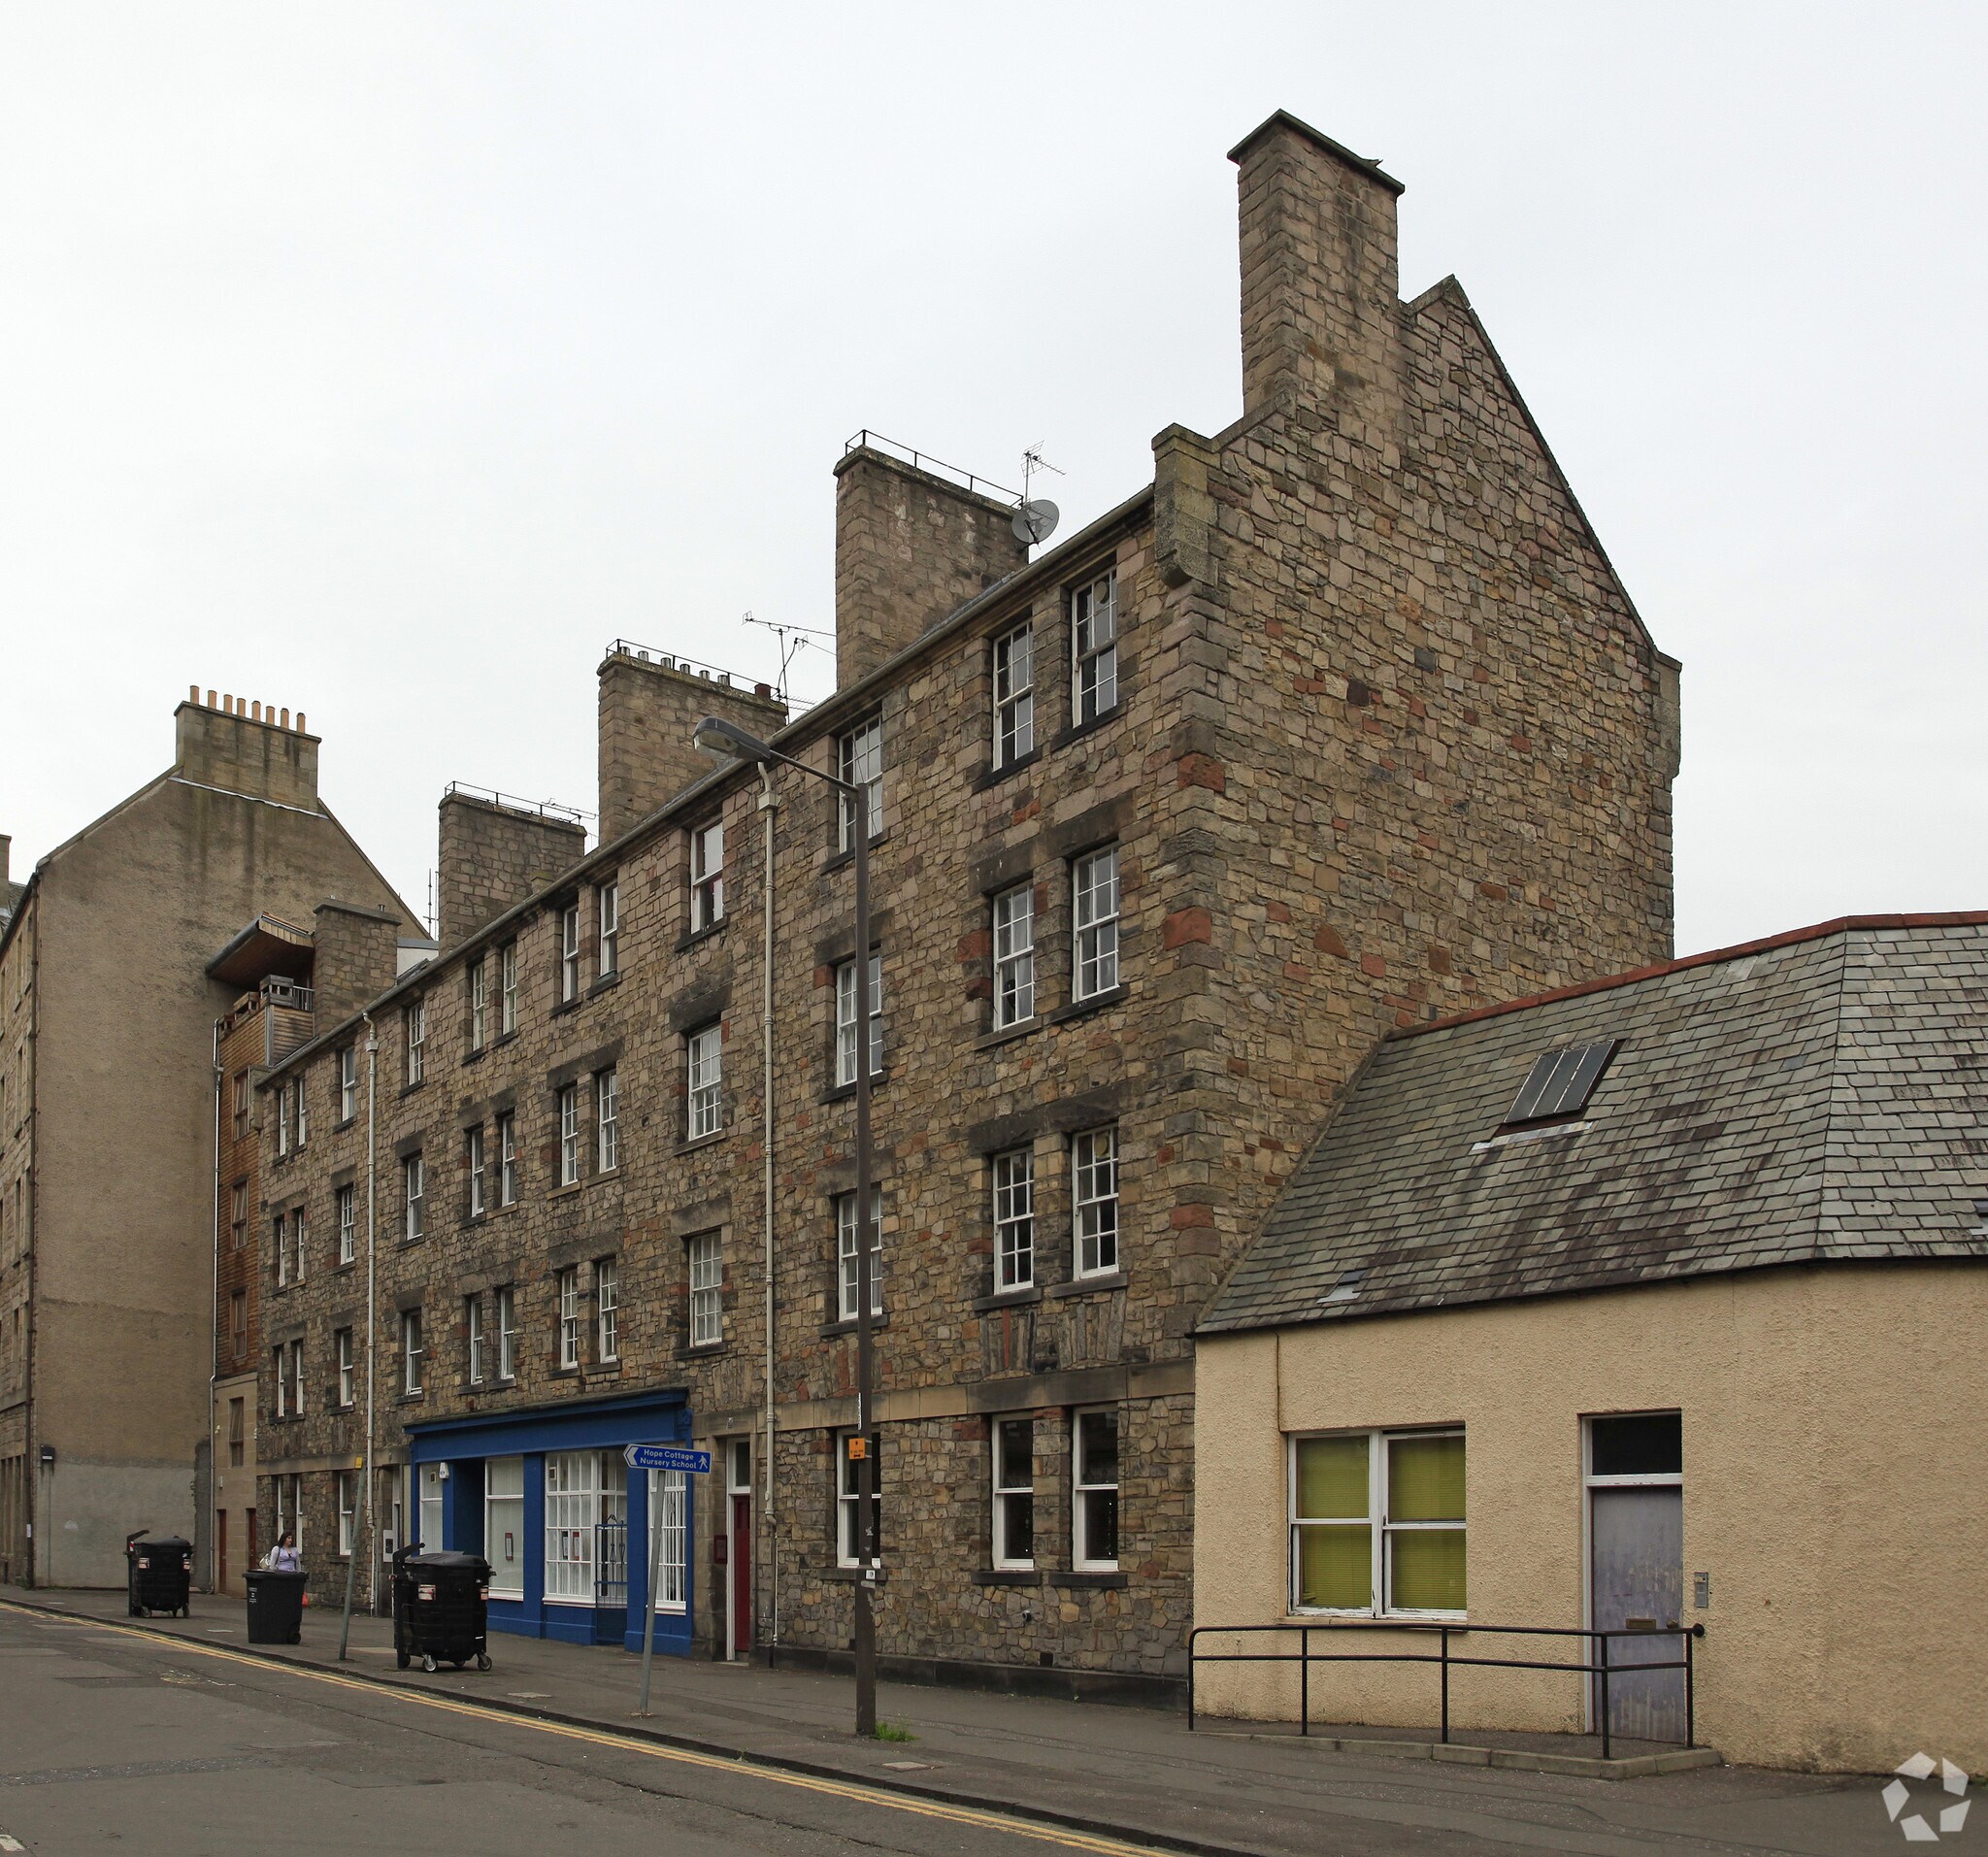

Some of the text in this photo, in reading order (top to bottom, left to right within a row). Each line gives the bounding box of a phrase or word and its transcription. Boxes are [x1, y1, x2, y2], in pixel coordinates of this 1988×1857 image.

[664, 1451, 694, 1460] Cottage
[640, 1458, 697, 1469] Nursery School
